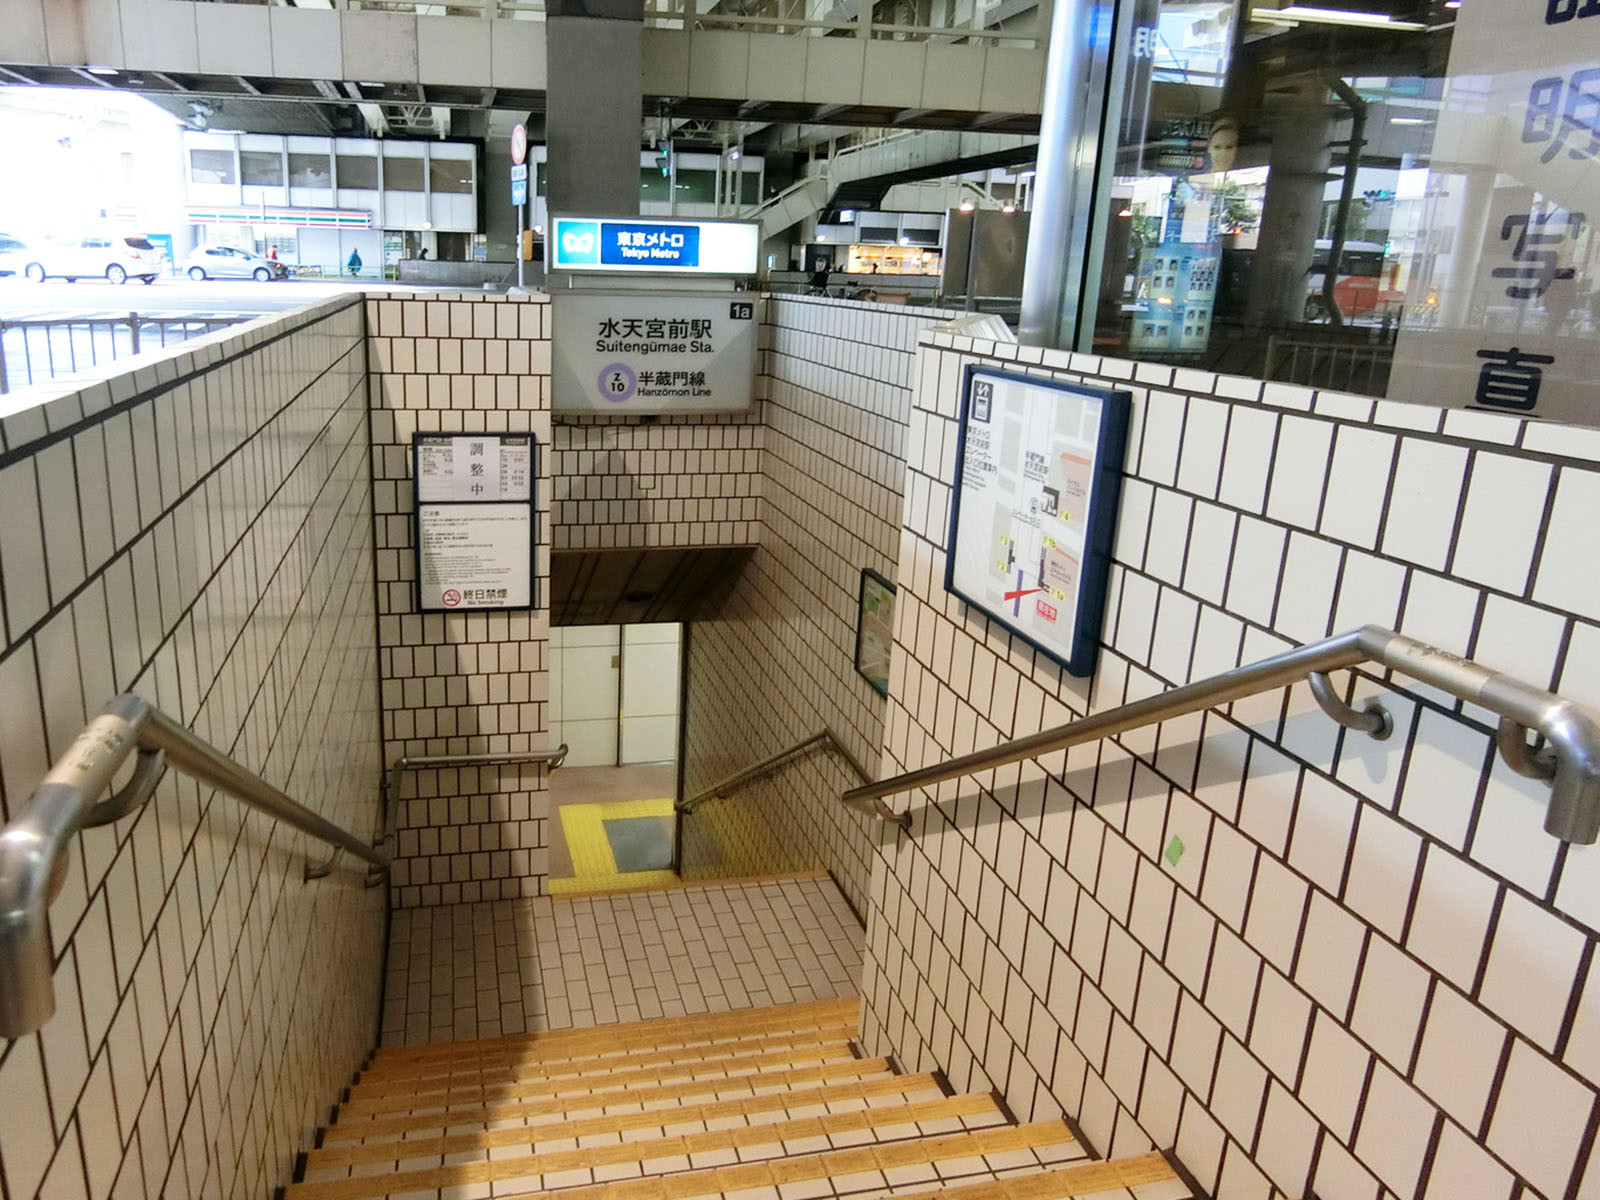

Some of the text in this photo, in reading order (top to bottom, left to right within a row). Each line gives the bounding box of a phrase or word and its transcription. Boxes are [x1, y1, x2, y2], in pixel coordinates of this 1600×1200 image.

[1465, 0, 1600, 416] 明写真
[617, 231, 685, 248] 東京メトロ
[621, 248, 680, 259] Tokyo Metro
[732, 305, 751, 319] 1a
[598, 317, 713, 340] 水天宮前駅
[596, 340, 715, 355] Suitengūmae Sta.
[613, 373, 621, 382] Z
[638, 371, 706, 387] 半蔵門線
[610, 382, 625, 392] 10
[692, 388, 712, 397] Line
[470, 442, 484, 496] 調整中
